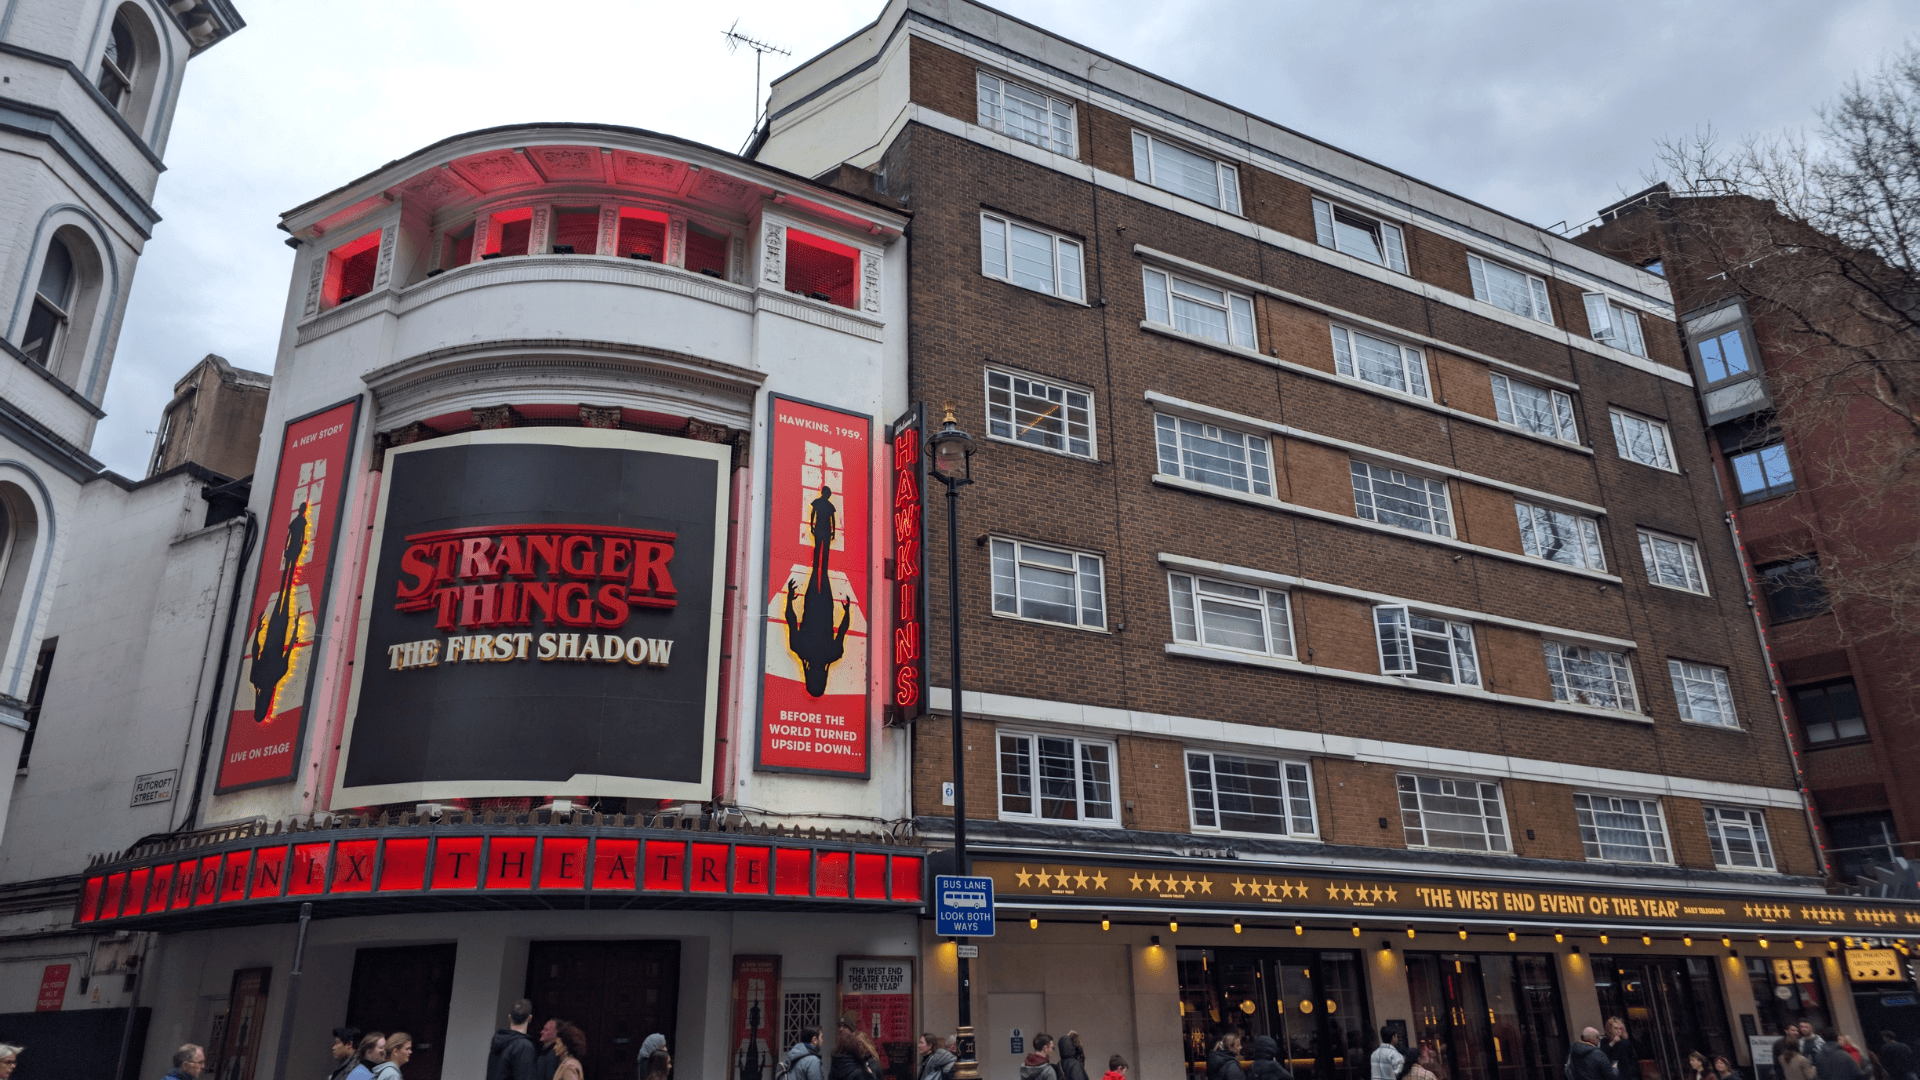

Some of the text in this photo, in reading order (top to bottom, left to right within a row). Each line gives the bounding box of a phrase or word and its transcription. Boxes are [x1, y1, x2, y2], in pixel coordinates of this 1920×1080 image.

[779, 414, 862, 440] HAWKINS, 1959.
[292, 423, 344, 449] A NEW STORY
[397, 534, 678, 599] STRANGER
[895, 428, 919, 707] HAWKINS
[432, 581, 629, 630] THINGS
[388, 633, 674, 670] THE FIRST SHADOW
[780, 710, 845, 726] BEFORE THE
[769, 723, 857, 741] WORLD TURNED
[231, 742, 290, 763] LIVE ON STAGE
[772, 739, 862, 756] UPSIDE DOWN...
[137, 778, 172, 792] FLITCROFT
[134, 790, 159, 803] STREET
[155, 851, 760, 902] PHOENIX THEATRE
[943, 880, 987, 890] BUS LANE
[1456, 890, 1498, 910] WEST
[1503, 892, 1535, 912] END
[1539, 894, 1585, 914] EVENT
[1589, 896, 1609, 915] OF
[1611, 898, 1639, 916] THE
[940, 912, 991, 921] LOOK BOTH
[954, 922, 978, 931] WAYS
[848, 975, 904, 983] THEATRE EVENT
[867, 966, 887, 975] WEST
[888, 967, 903, 975] END
[852, 983, 862, 991] OF
[864, 983, 878, 991] THE
